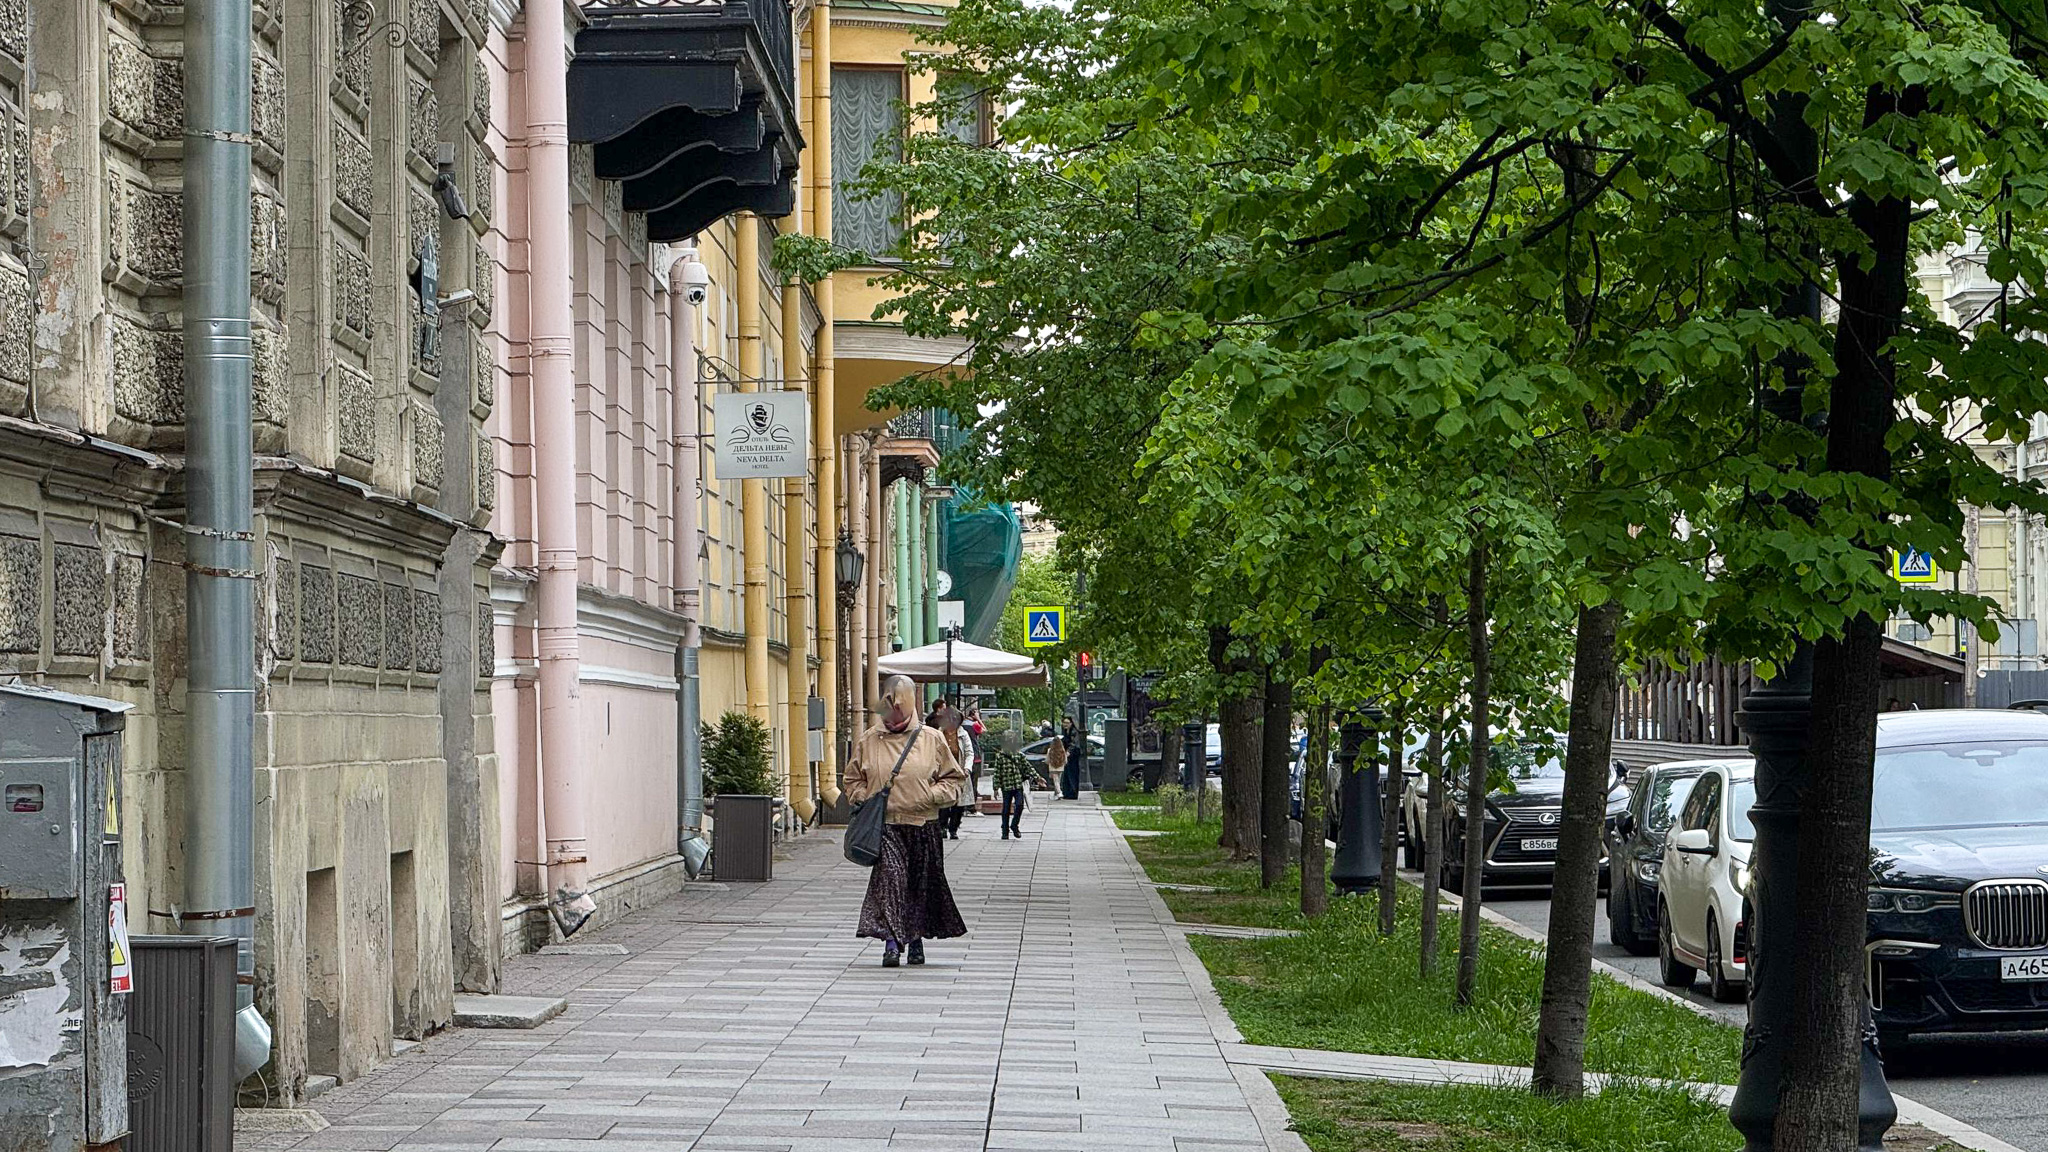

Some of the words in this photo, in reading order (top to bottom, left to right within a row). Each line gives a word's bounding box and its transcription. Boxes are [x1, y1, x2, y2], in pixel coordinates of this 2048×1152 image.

[733, 445, 764, 453] ДЕЛЬТА
[765, 444, 788, 452] НЕВЫ
[736, 455, 758, 463] NEVA
[759, 455, 785, 463] DELTA
